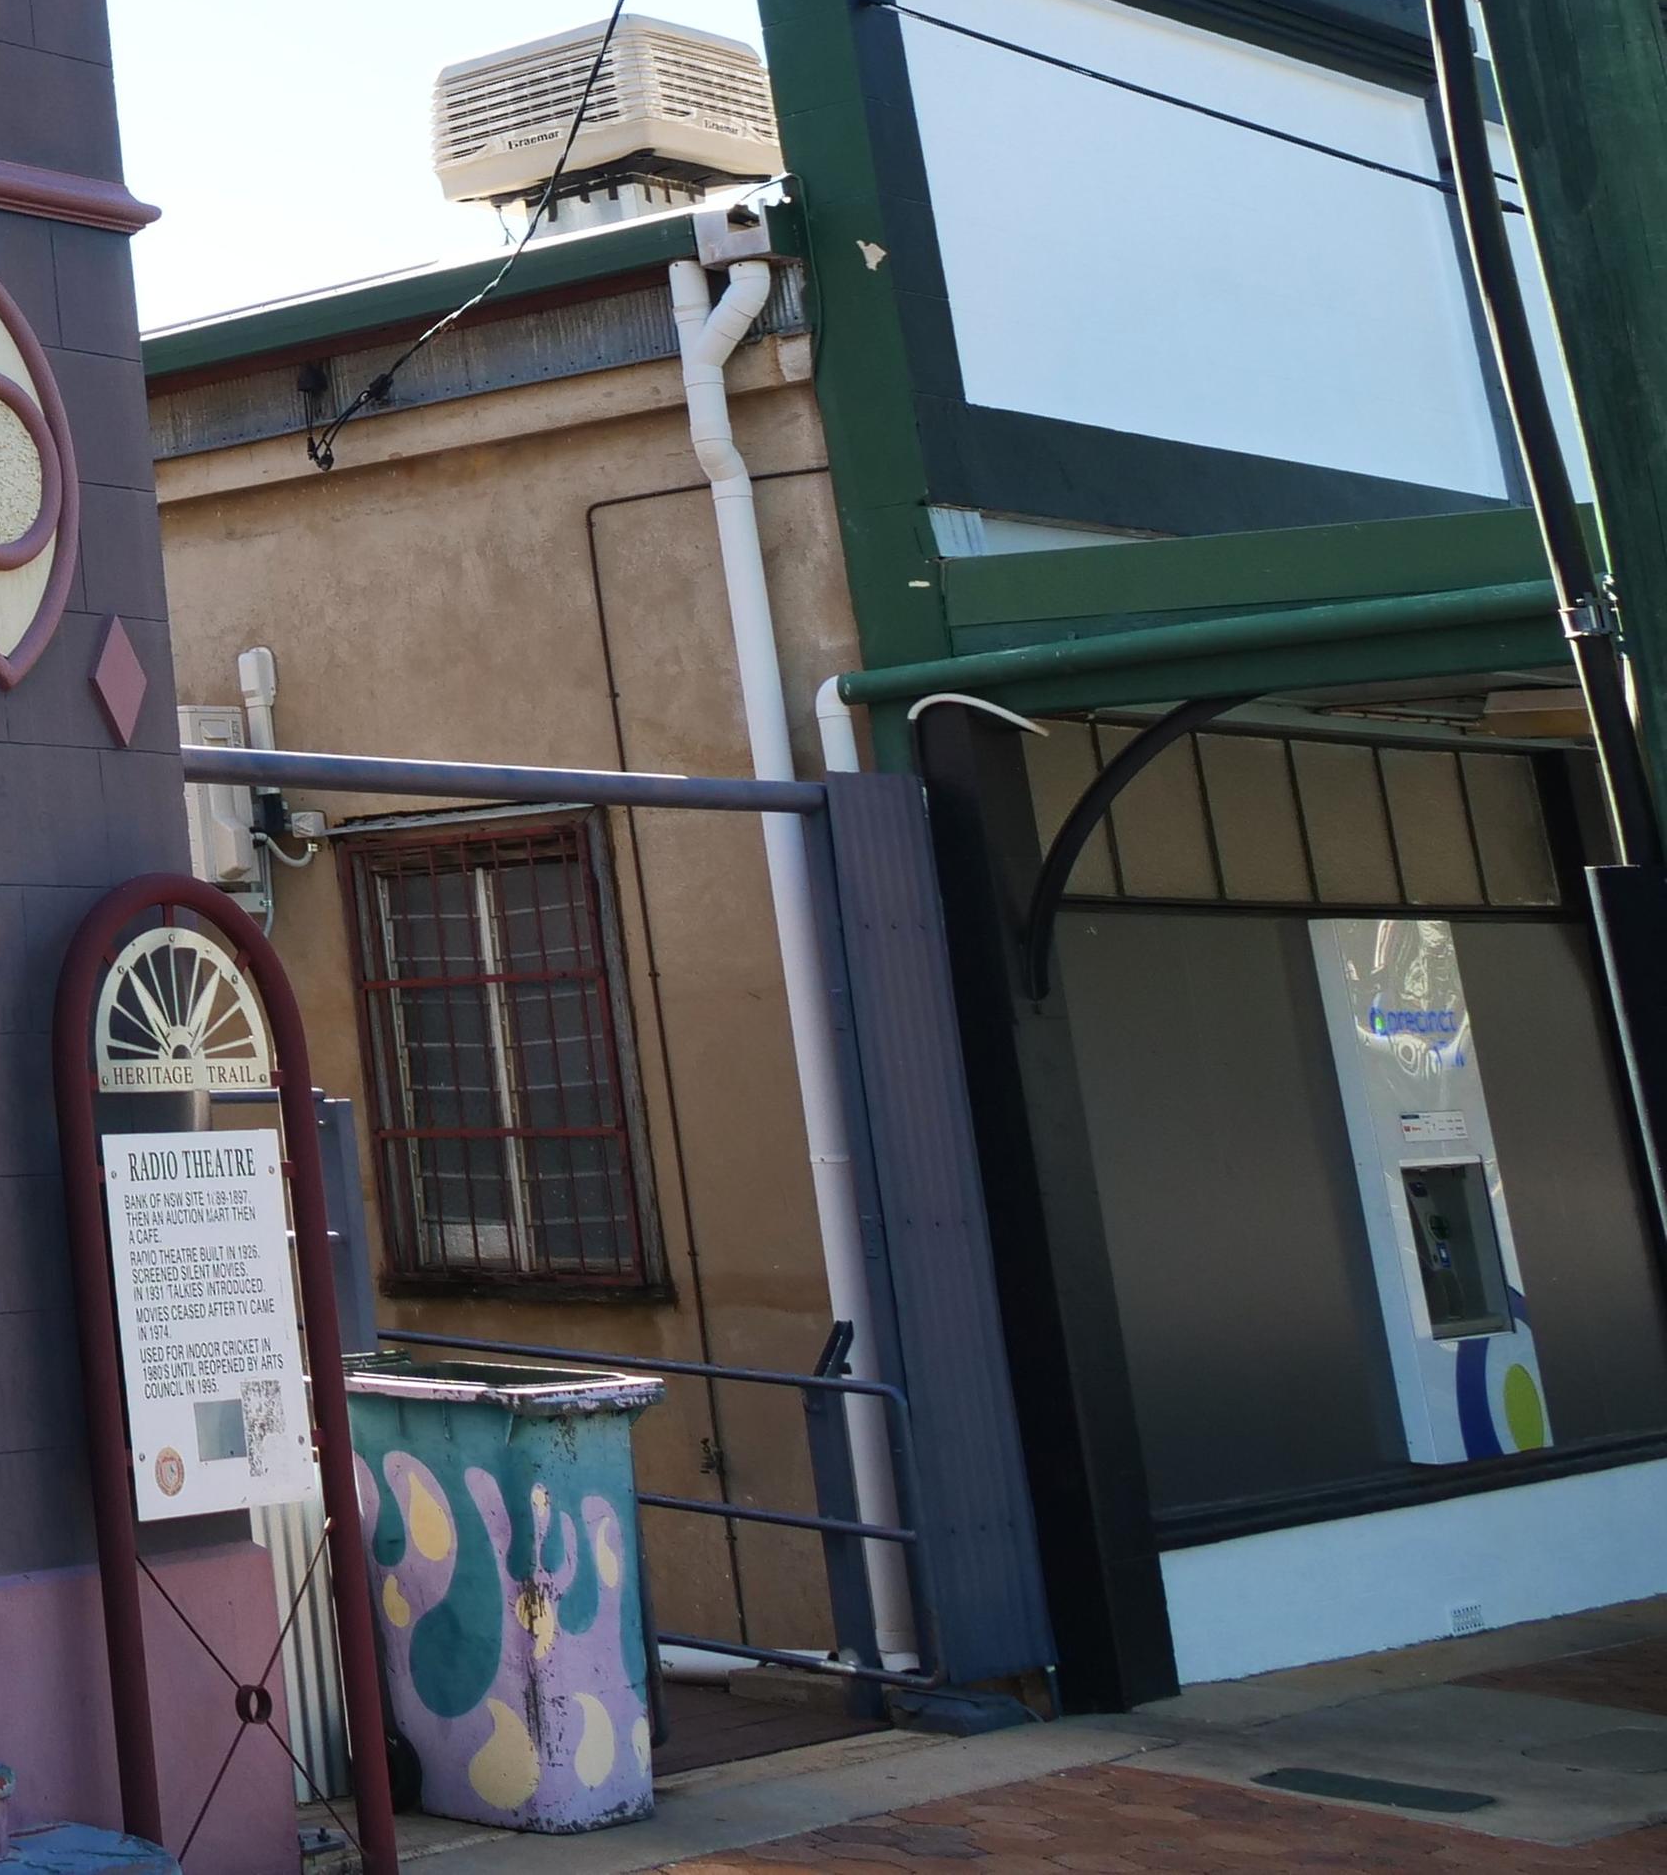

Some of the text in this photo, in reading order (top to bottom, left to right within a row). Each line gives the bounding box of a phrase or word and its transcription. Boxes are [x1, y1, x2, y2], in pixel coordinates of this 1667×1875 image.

[114, 1065, 255, 1085] HERITAGE TRAIL
[128, 1148, 256, 1181] RADIO THEATRE
[124, 1194, 148, 1209] BANK
[150, 1194, 161, 1208] OF
[163, 1192, 183, 1208] NSW
[185, 1191, 204, 1206] SITE
[127, 1212, 149, 1227] THEN
[152, 1211, 164, 1226] AN
[166, 1209, 205, 1225] AUCTION
[232, 1206, 256, 1221] THEN
[129, 1229, 162, 1244] A CAFE.
[159, 1248, 197, 1264] THEATRE
[199, 1247, 224, 1262] BUILT
[226, 1246, 236, 1260] IN
[238, 1245, 260, 1260] 1926.
[132, 1263, 249, 1284] SCREENED SILENT MOVIES.
[133, 1287, 143, 1301] IN
[145, 1285, 163, 1300] 1931
[207, 1279, 265, 1296] INTRODUCED.
[136, 1299, 275, 1322] MOVIES CEASED AFTER TV CAME
[138, 1326, 147, 1341] IN
[140, 1339, 271, 1363] USED FOR INDOOR CRICKET IN
[171, 1363, 197, 1378] UNTIL
[198, 1358, 245, 1375] REOPENED
[247, 1357, 259, 1371] BY
[261, 1354, 284, 1370] ARTS
[145, 1379, 219, 1399] COUNCIL IN 1995.
